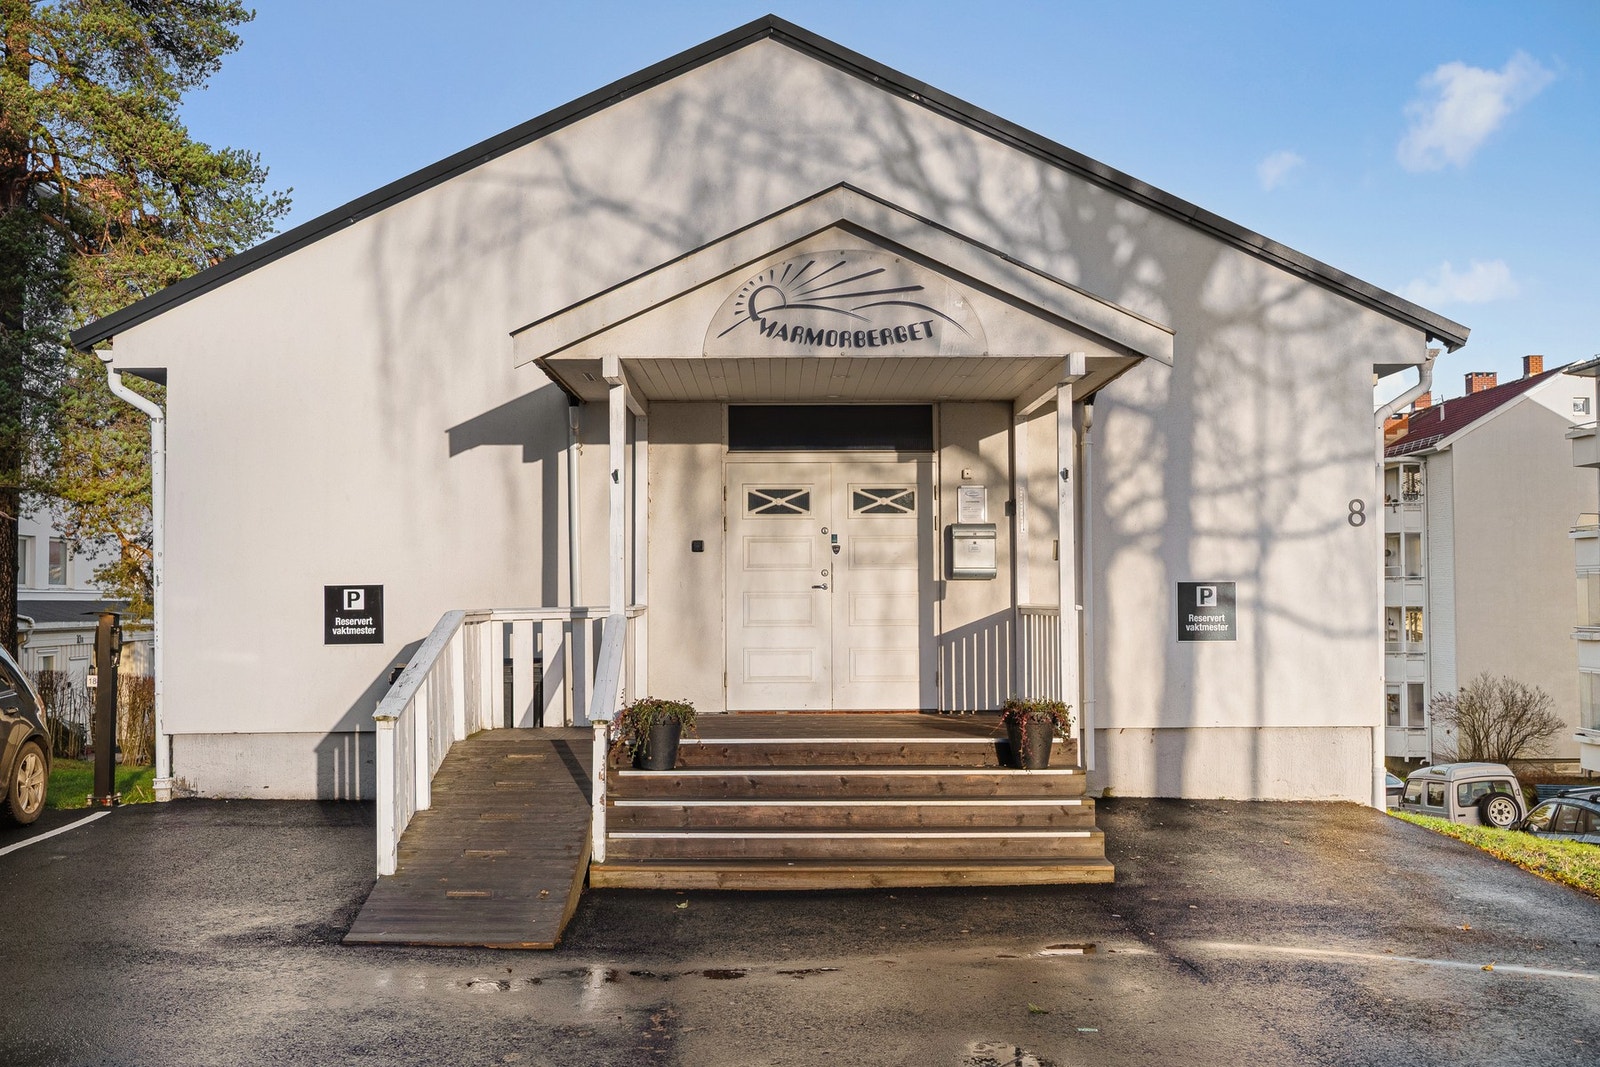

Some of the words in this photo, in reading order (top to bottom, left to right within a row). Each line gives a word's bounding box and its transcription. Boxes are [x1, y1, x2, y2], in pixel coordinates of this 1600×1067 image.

[759, 317, 934, 349] MARMORBERGET
[1348, 498, 1366, 527] 8
[347, 590, 361, 608] P
[1199, 587, 1214, 605] P
[335, 616, 373, 626] Reservert
[1188, 613, 1225, 622] Reservert
[331, 626, 377, 635] vaktmester
[1185, 623, 1229, 631] vaktmester
